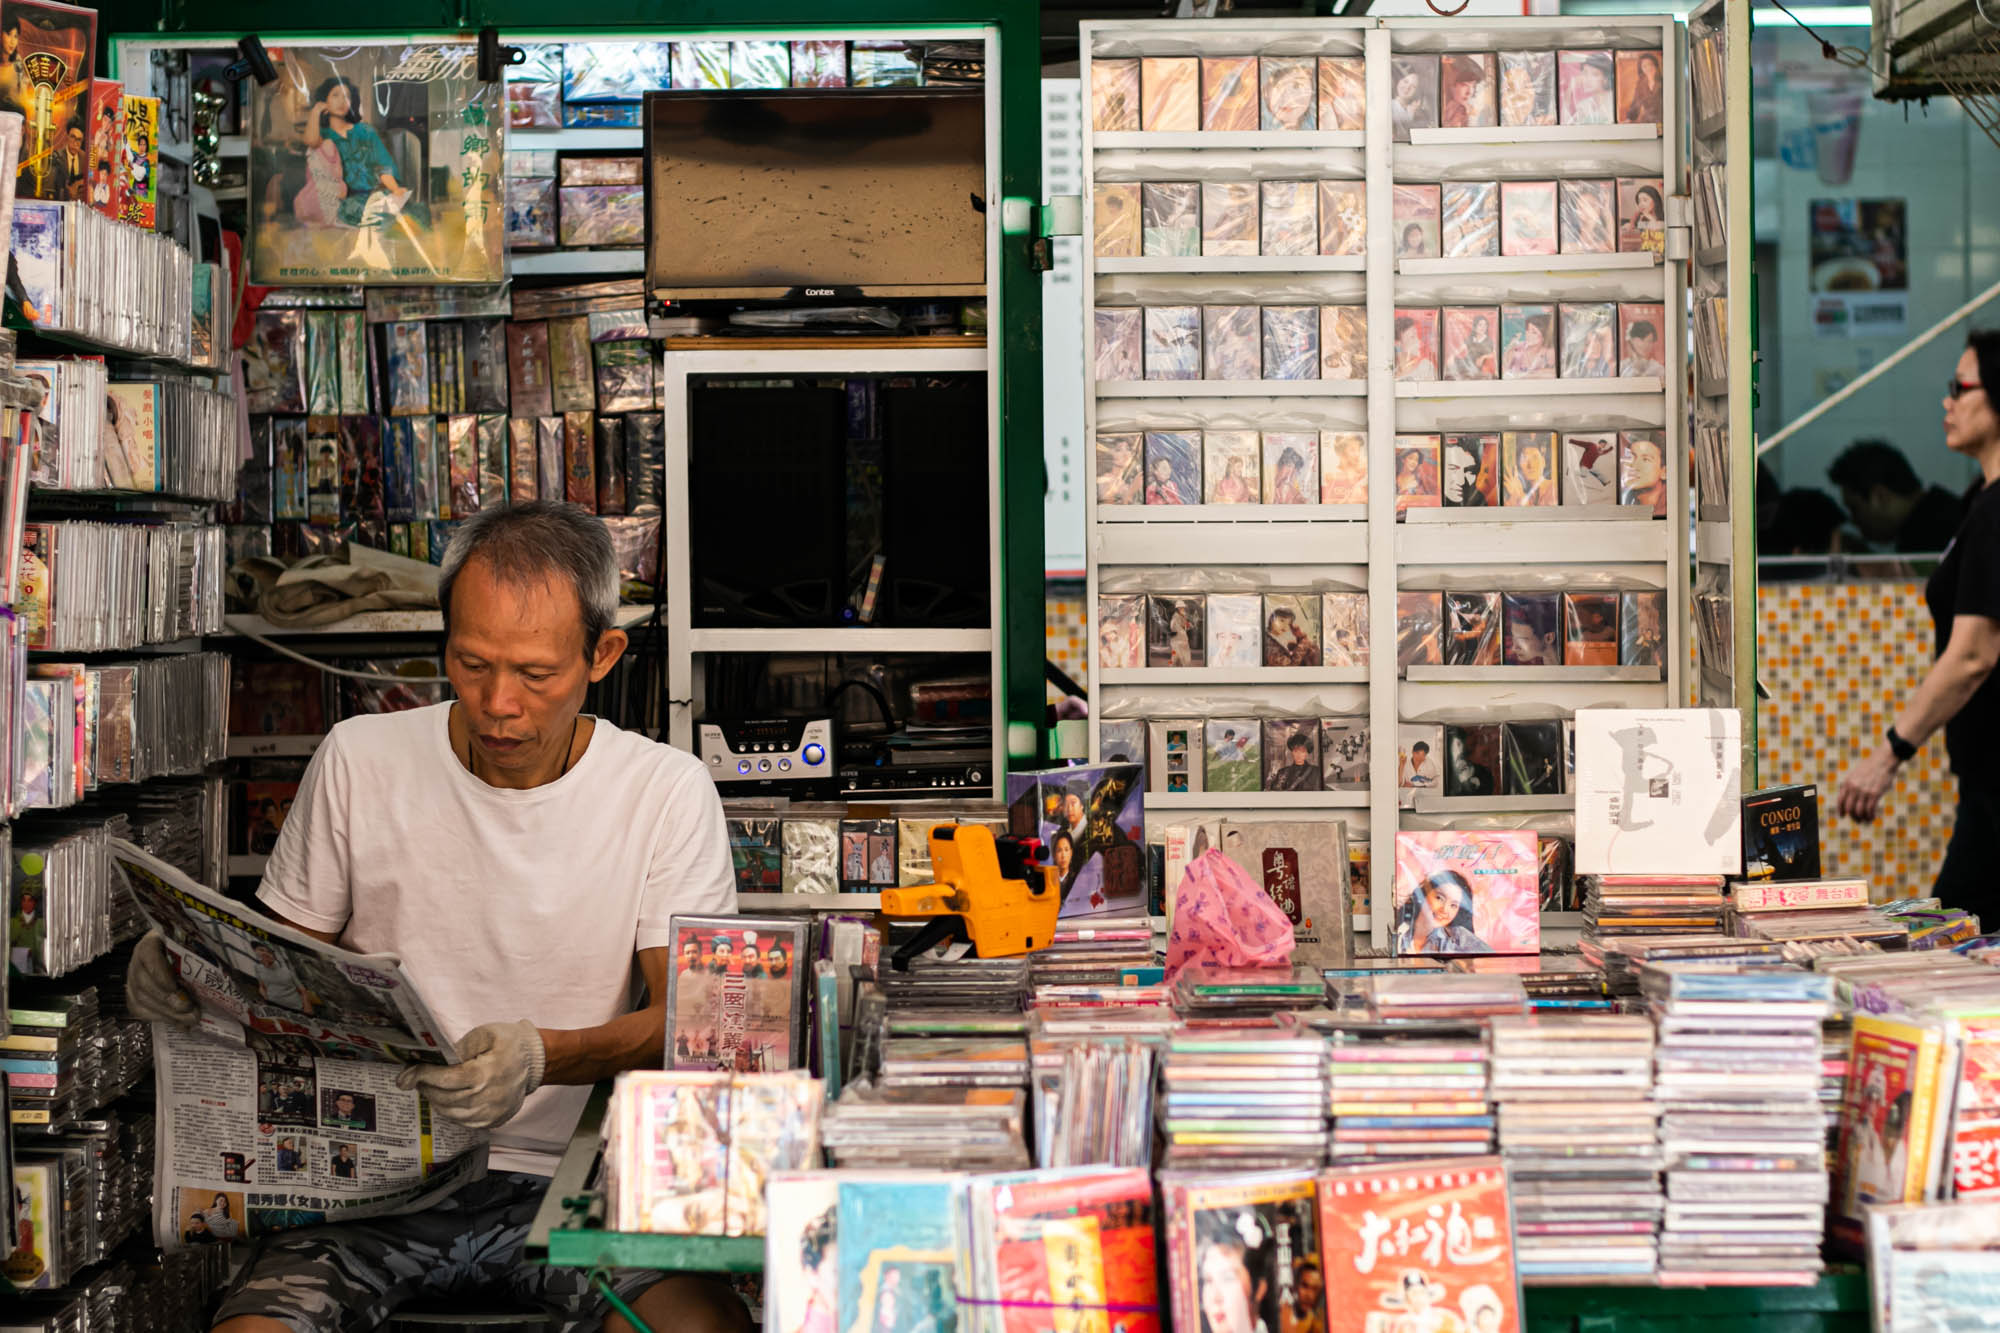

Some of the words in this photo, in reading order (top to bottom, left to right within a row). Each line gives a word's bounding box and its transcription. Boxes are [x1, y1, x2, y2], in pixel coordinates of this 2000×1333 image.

[805, 288, 835, 296] Contex
[1760, 806, 1801, 827] CONGO
[1815, 887, 1859, 900] 舞台劇
[721, 973, 747, 1050] 三國演義
